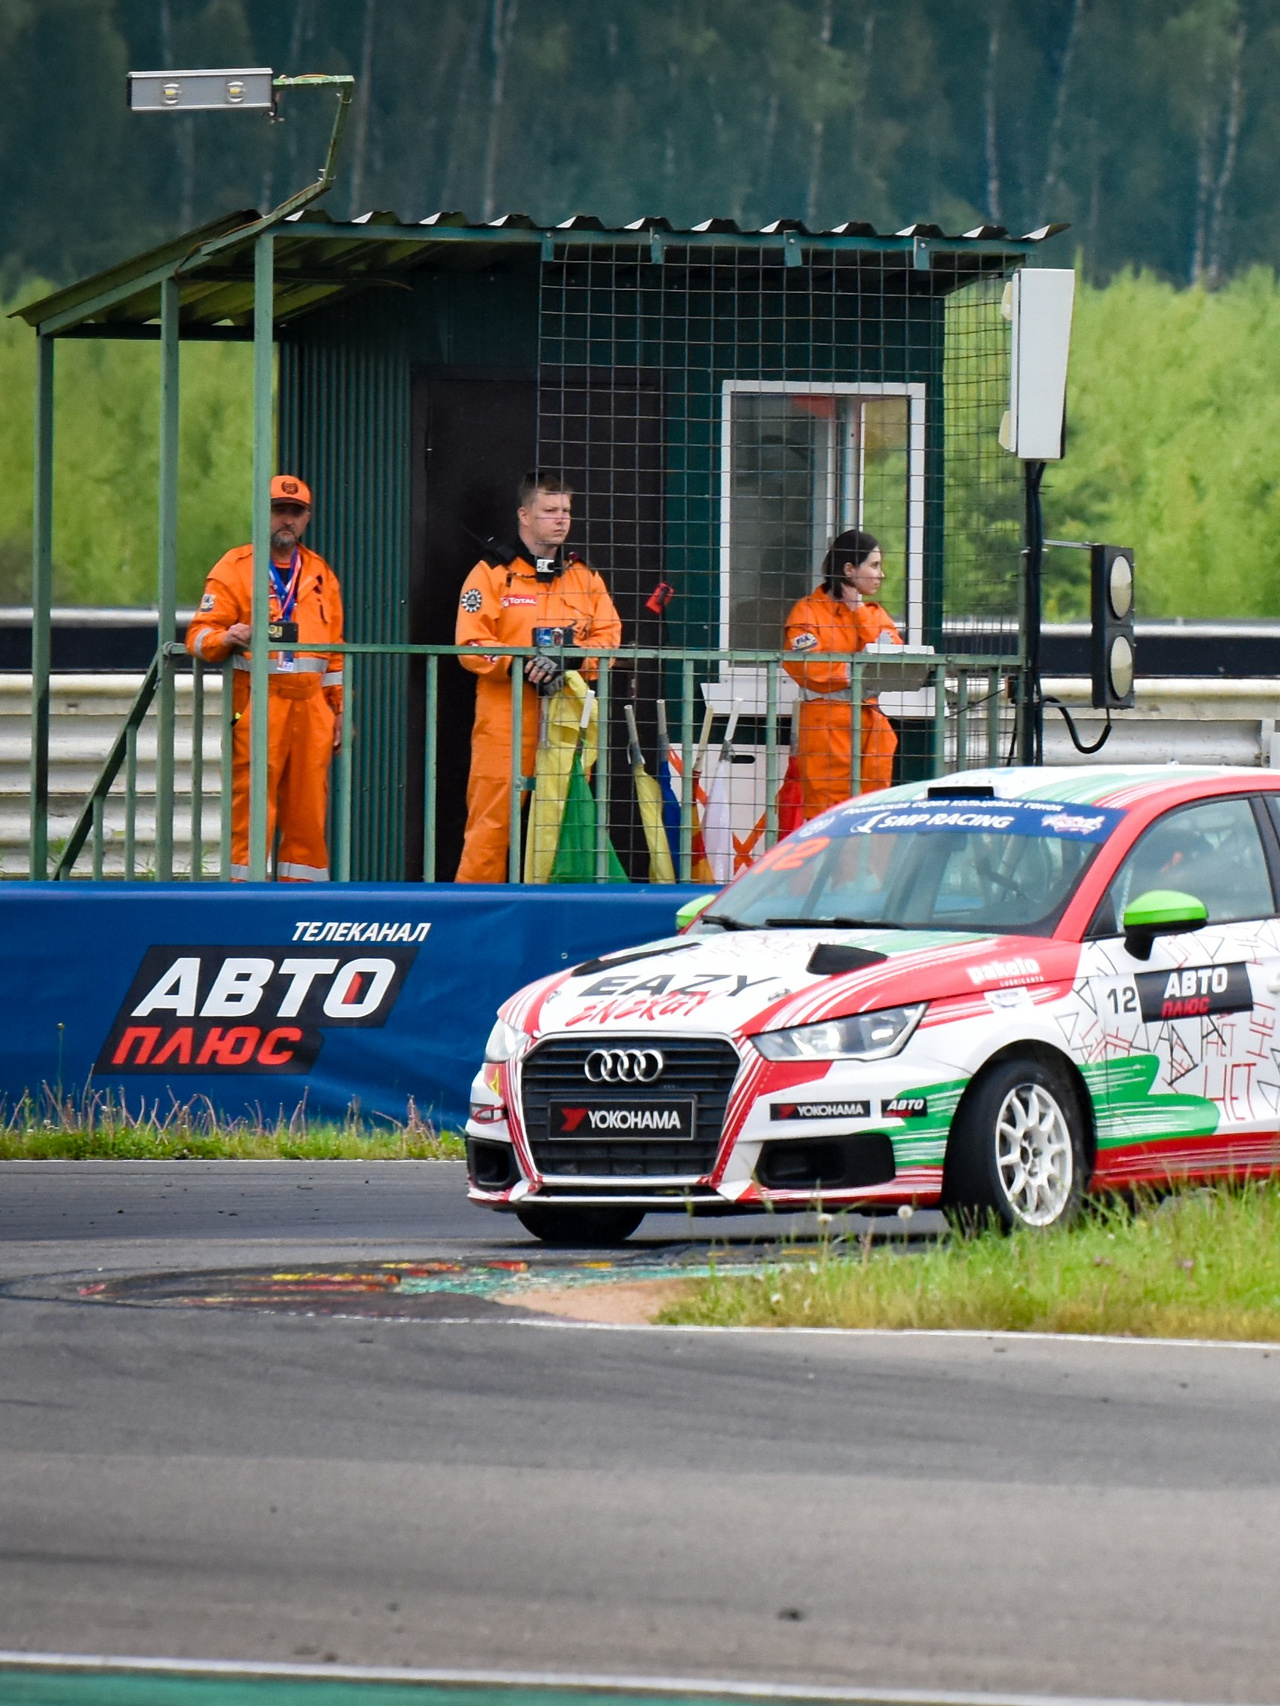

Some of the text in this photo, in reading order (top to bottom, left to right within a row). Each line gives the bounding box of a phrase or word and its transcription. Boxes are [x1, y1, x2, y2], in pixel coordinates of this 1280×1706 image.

[879, 813, 1014, 829] SMP RACING
[291, 921, 432, 942] ТЕЛЕКАНАЛ
[966, 957, 1041, 986] pakelo
[1163, 966, 1229, 999] АВТО
[130, 957, 396, 1018] АВТО
[577, 973, 783, 998] EAZY
[565, 989, 730, 1027] ENERGY
[1107, 985, 1138, 1015] 12
[1161, 997, 1212, 1018] ПЛЮС
[111, 1026, 303, 1065] ПЛЮС
[796, 1104, 864, 1117] YOKOHAMA
[886, 1099, 925, 1110] АВТО
[587, 1109, 682, 1130] YOKOHAMA
